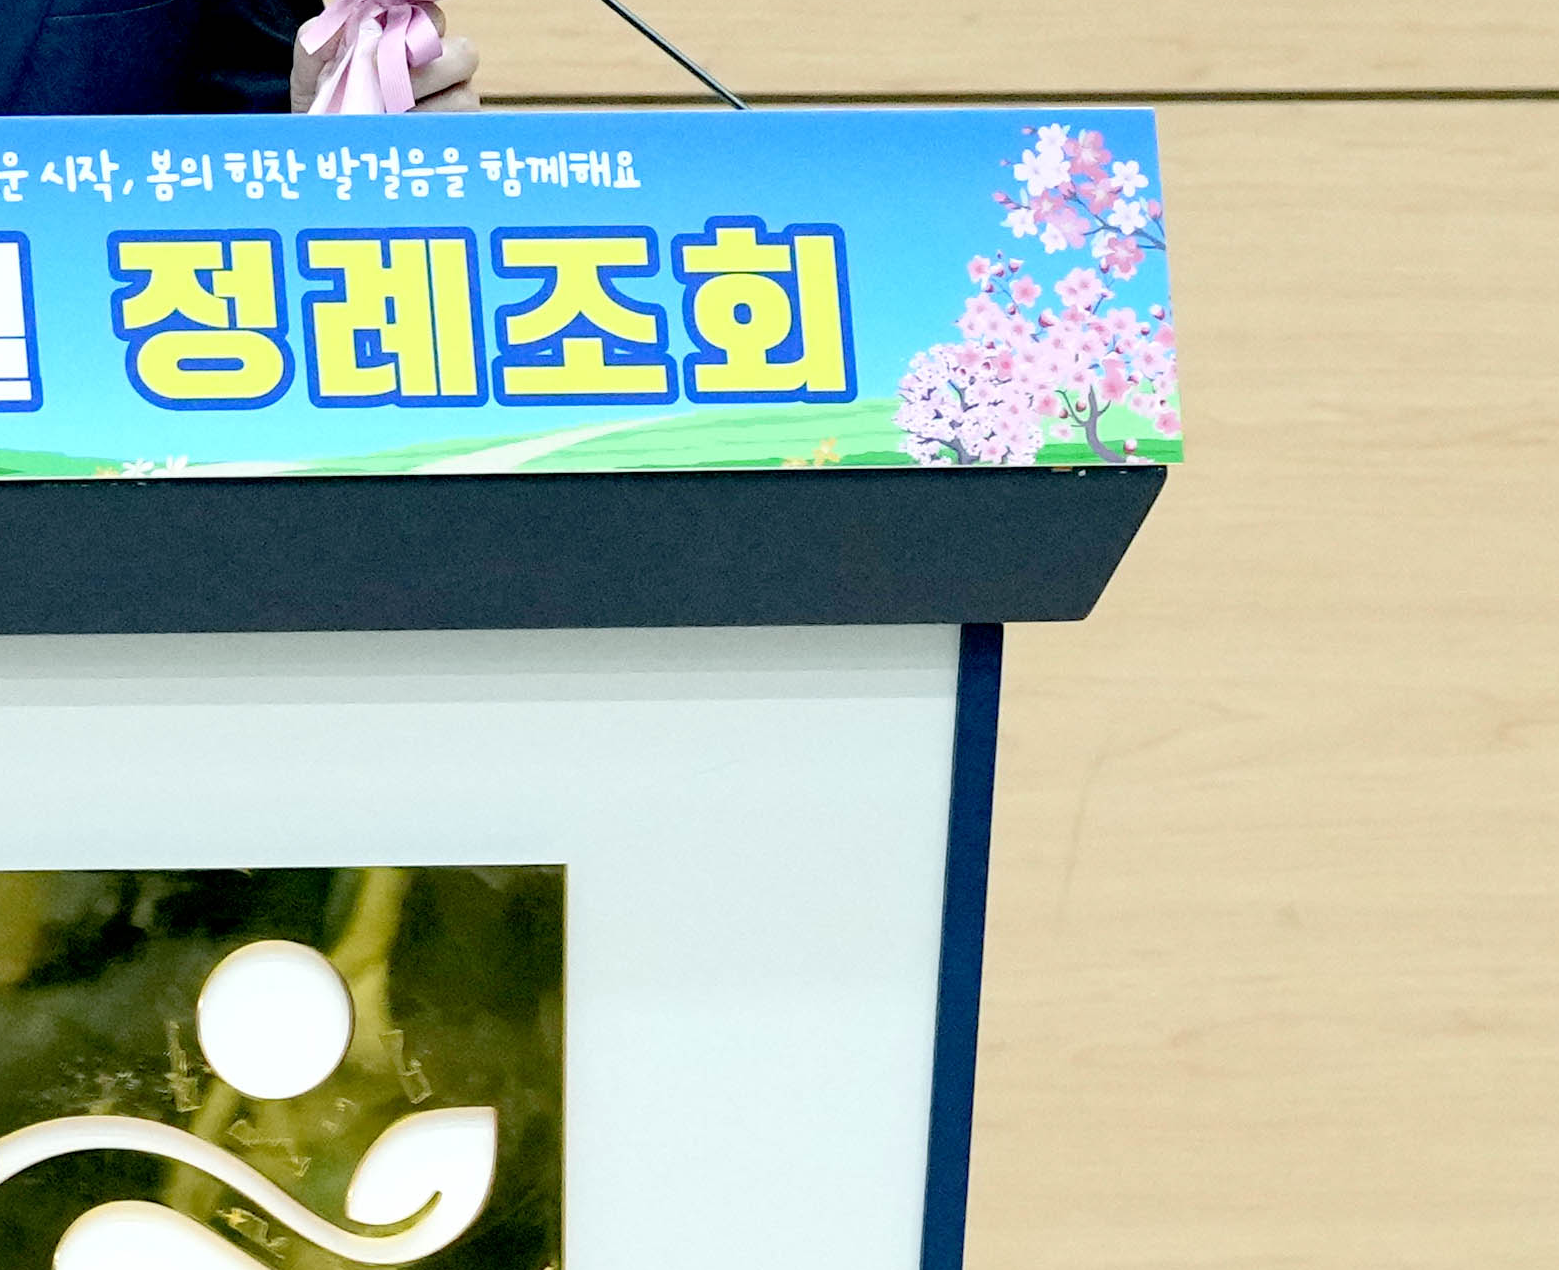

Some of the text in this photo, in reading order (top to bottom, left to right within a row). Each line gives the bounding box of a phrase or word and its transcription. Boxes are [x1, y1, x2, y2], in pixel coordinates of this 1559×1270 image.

[39, 149, 135, 203] 시작,
[145, 148, 214, 203] 봄의
[223, 149, 306, 201] 힘찬
[316, 147, 469, 201] 발걸음을
[479, 147, 642, 198] 함께해요
[112, 218, 855, 408] 정례조회
